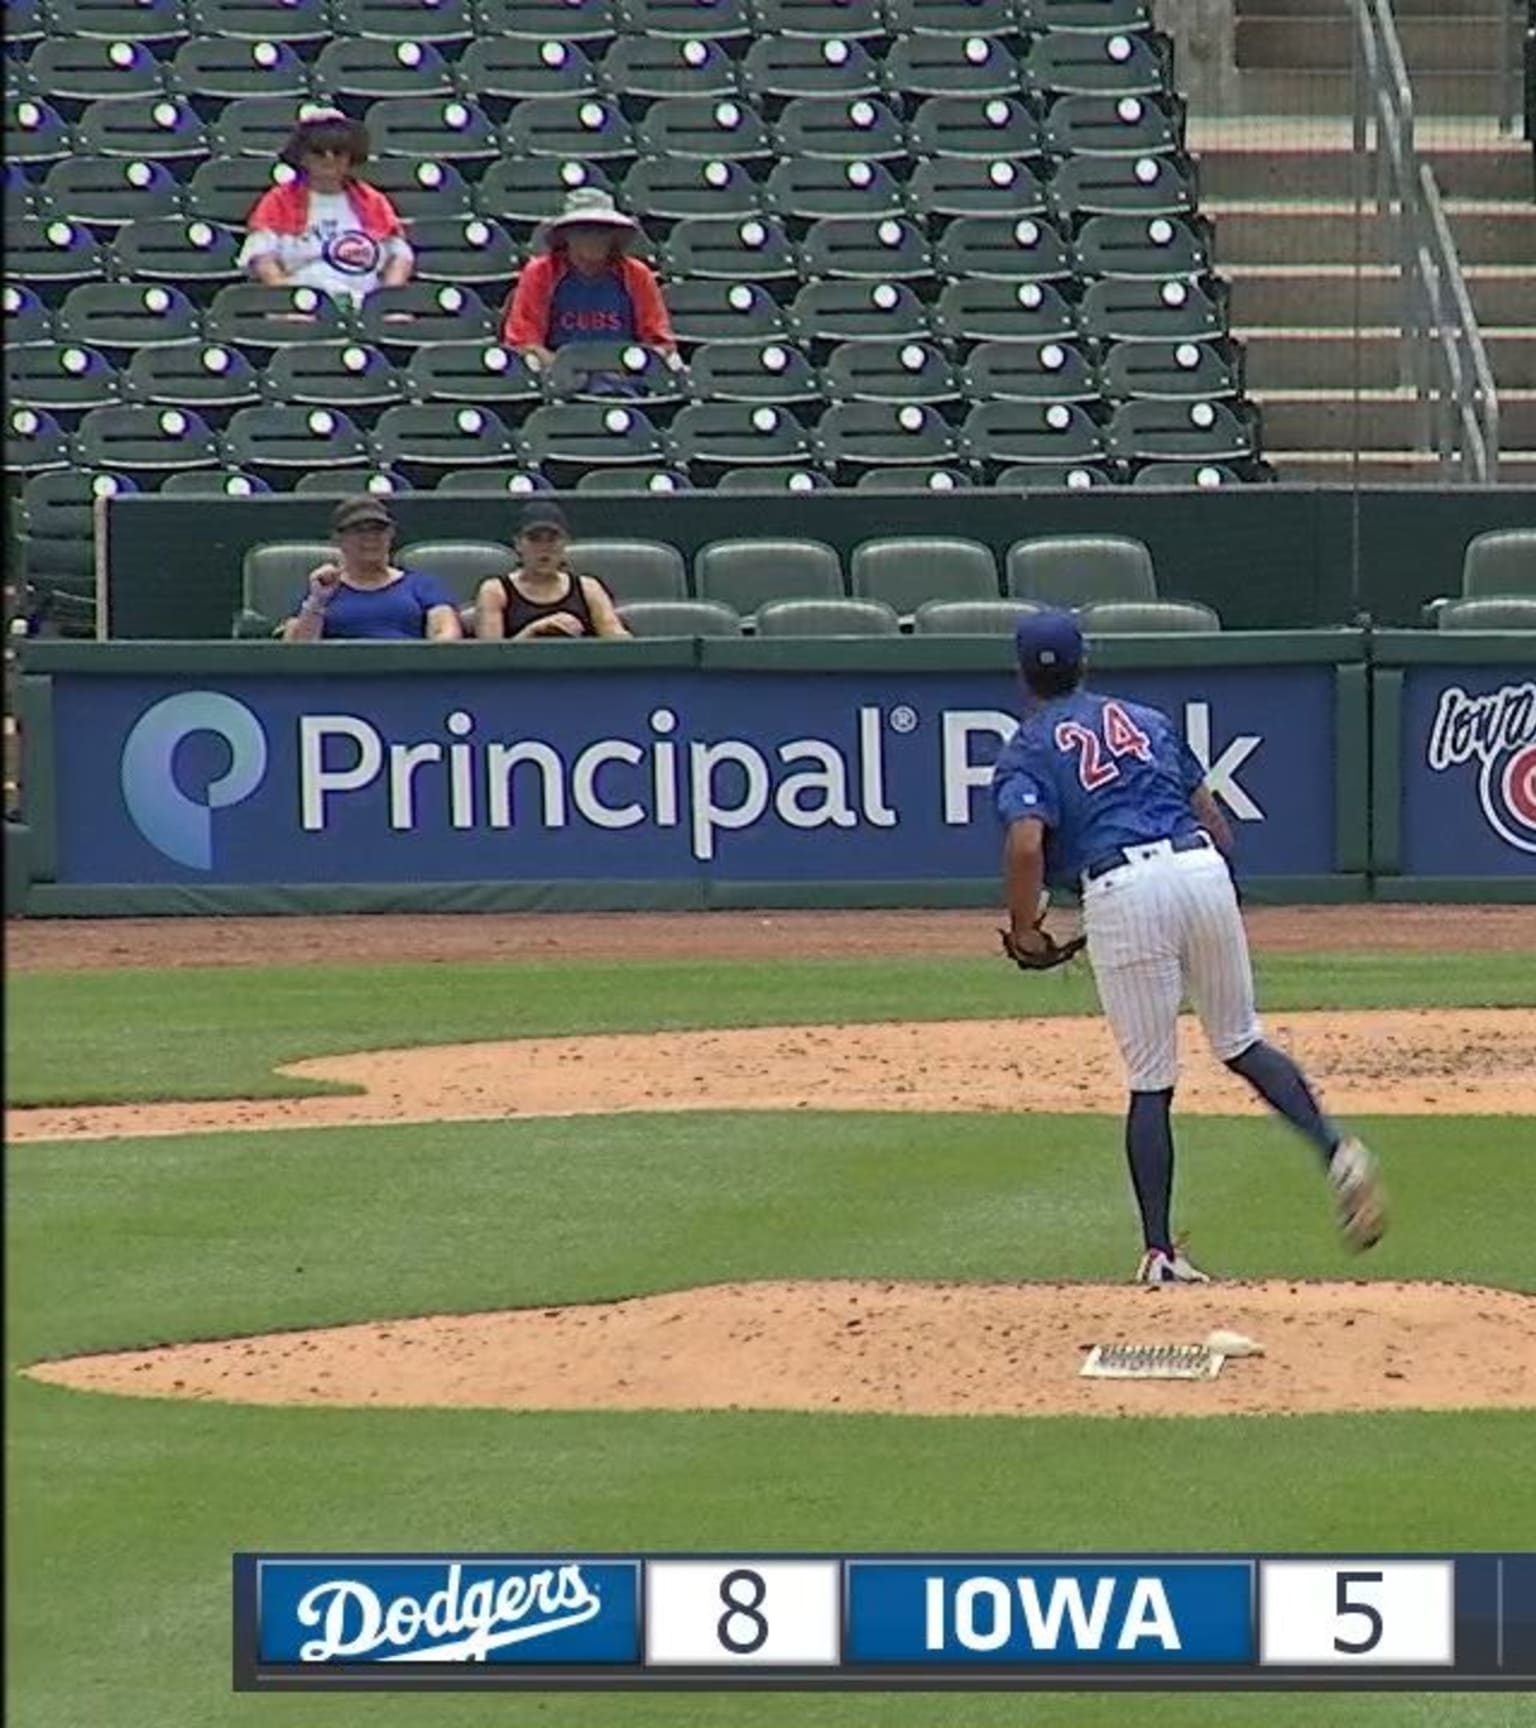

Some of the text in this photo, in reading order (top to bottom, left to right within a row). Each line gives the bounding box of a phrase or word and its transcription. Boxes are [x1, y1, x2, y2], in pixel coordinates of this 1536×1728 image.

[560, 311, 622, 331] CUBS
[942, 702, 1265, 825] Pk
[1055, 701, 1151, 792] 24
